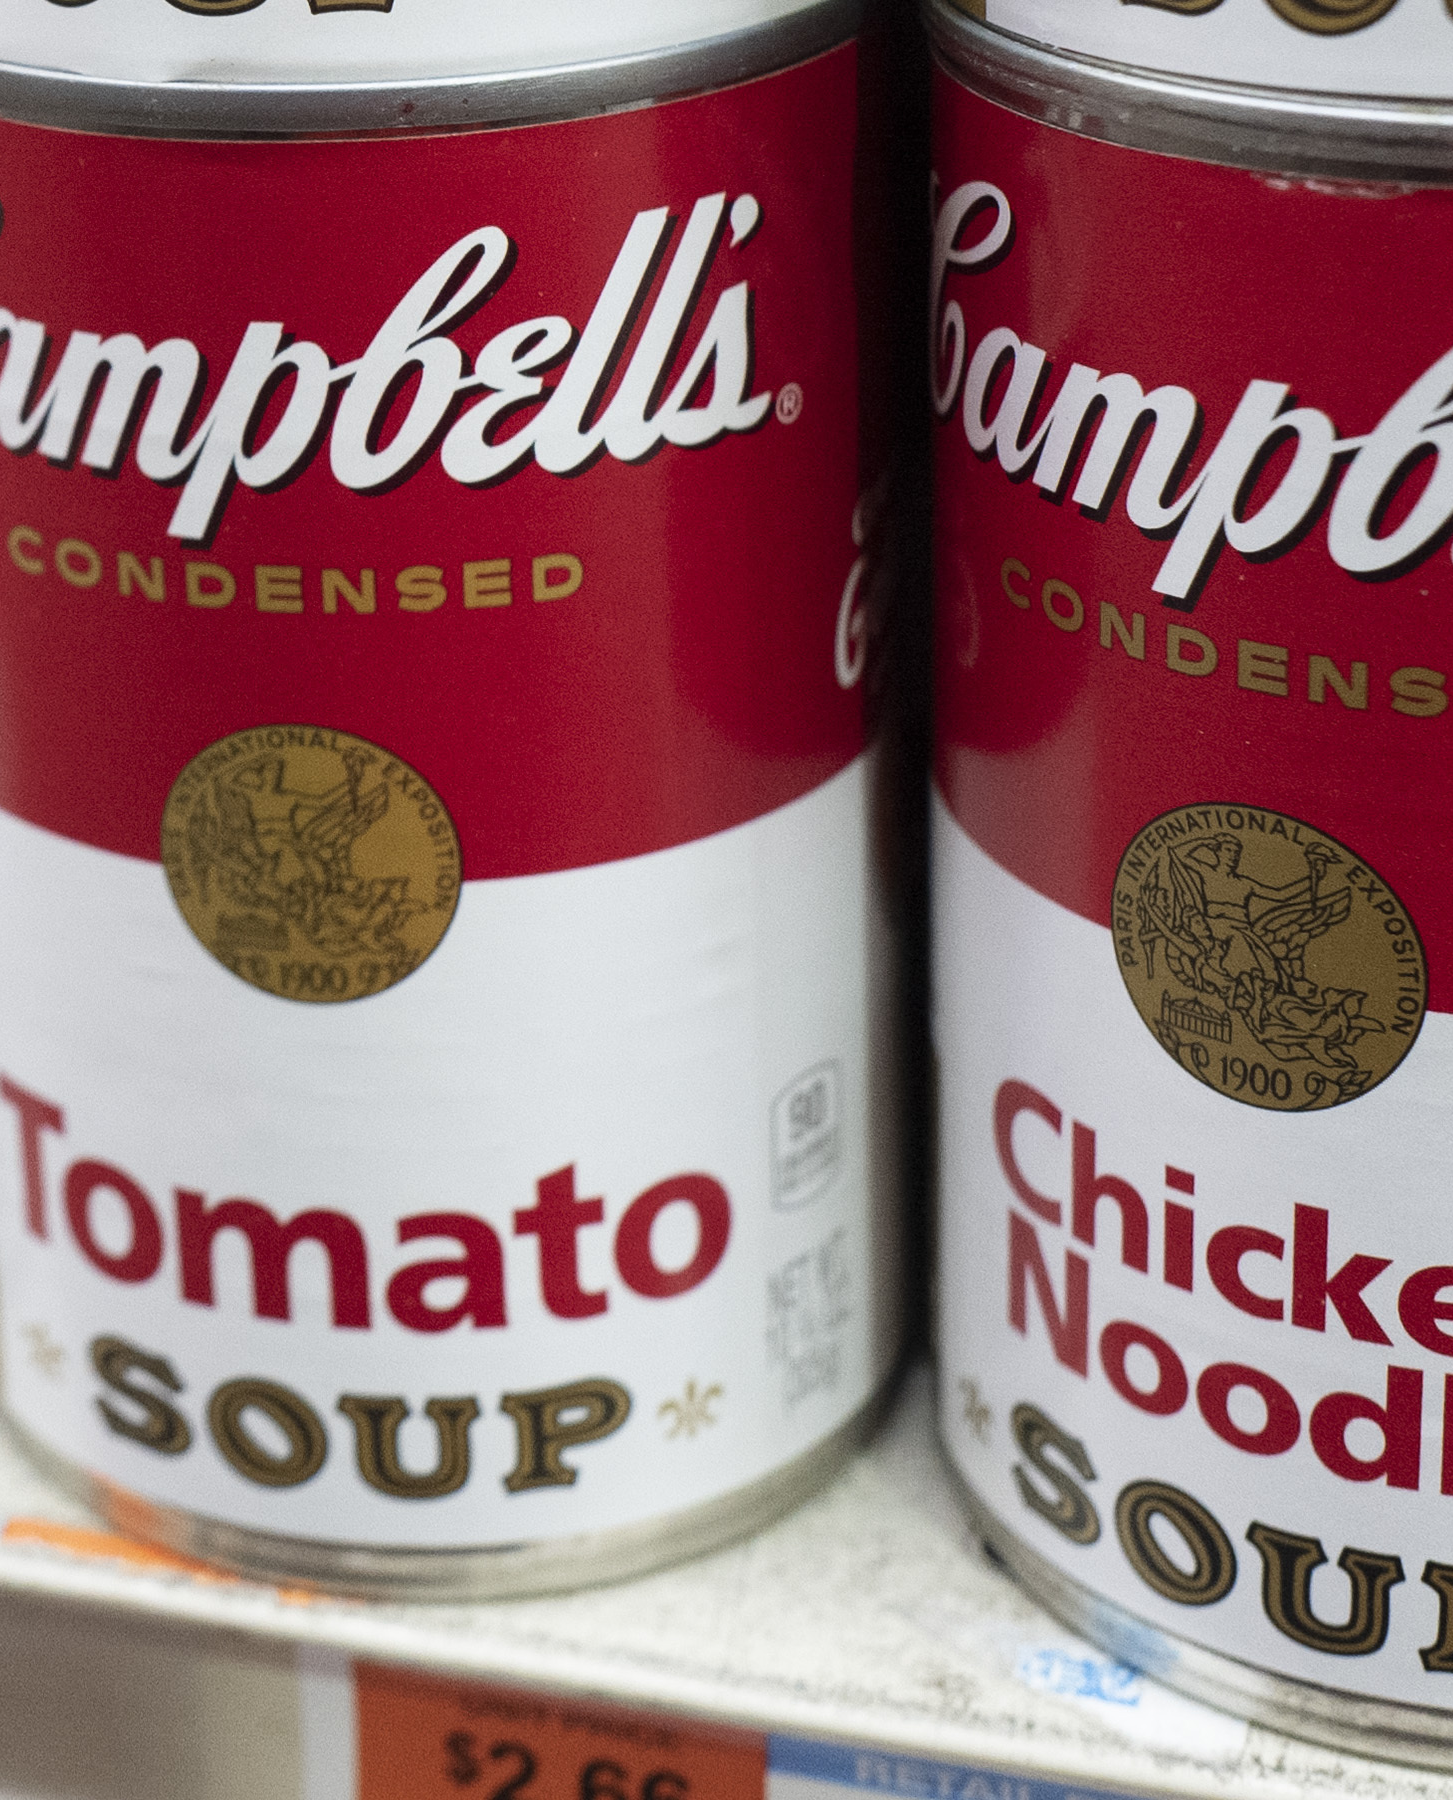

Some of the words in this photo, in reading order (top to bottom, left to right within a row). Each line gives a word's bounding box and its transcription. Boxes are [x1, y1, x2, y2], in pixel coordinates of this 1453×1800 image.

[7, 525, 585, 616] CONDENSED
[1124, 808, 1311, 882] INTERNATIONAL
[1115, 888, 1140, 968] PARIS
[1344, 865, 1423, 1037] EXPOSITION
[1219, 1055, 1293, 1102] 1900
[88, 1332, 634, 1502] SOUP
